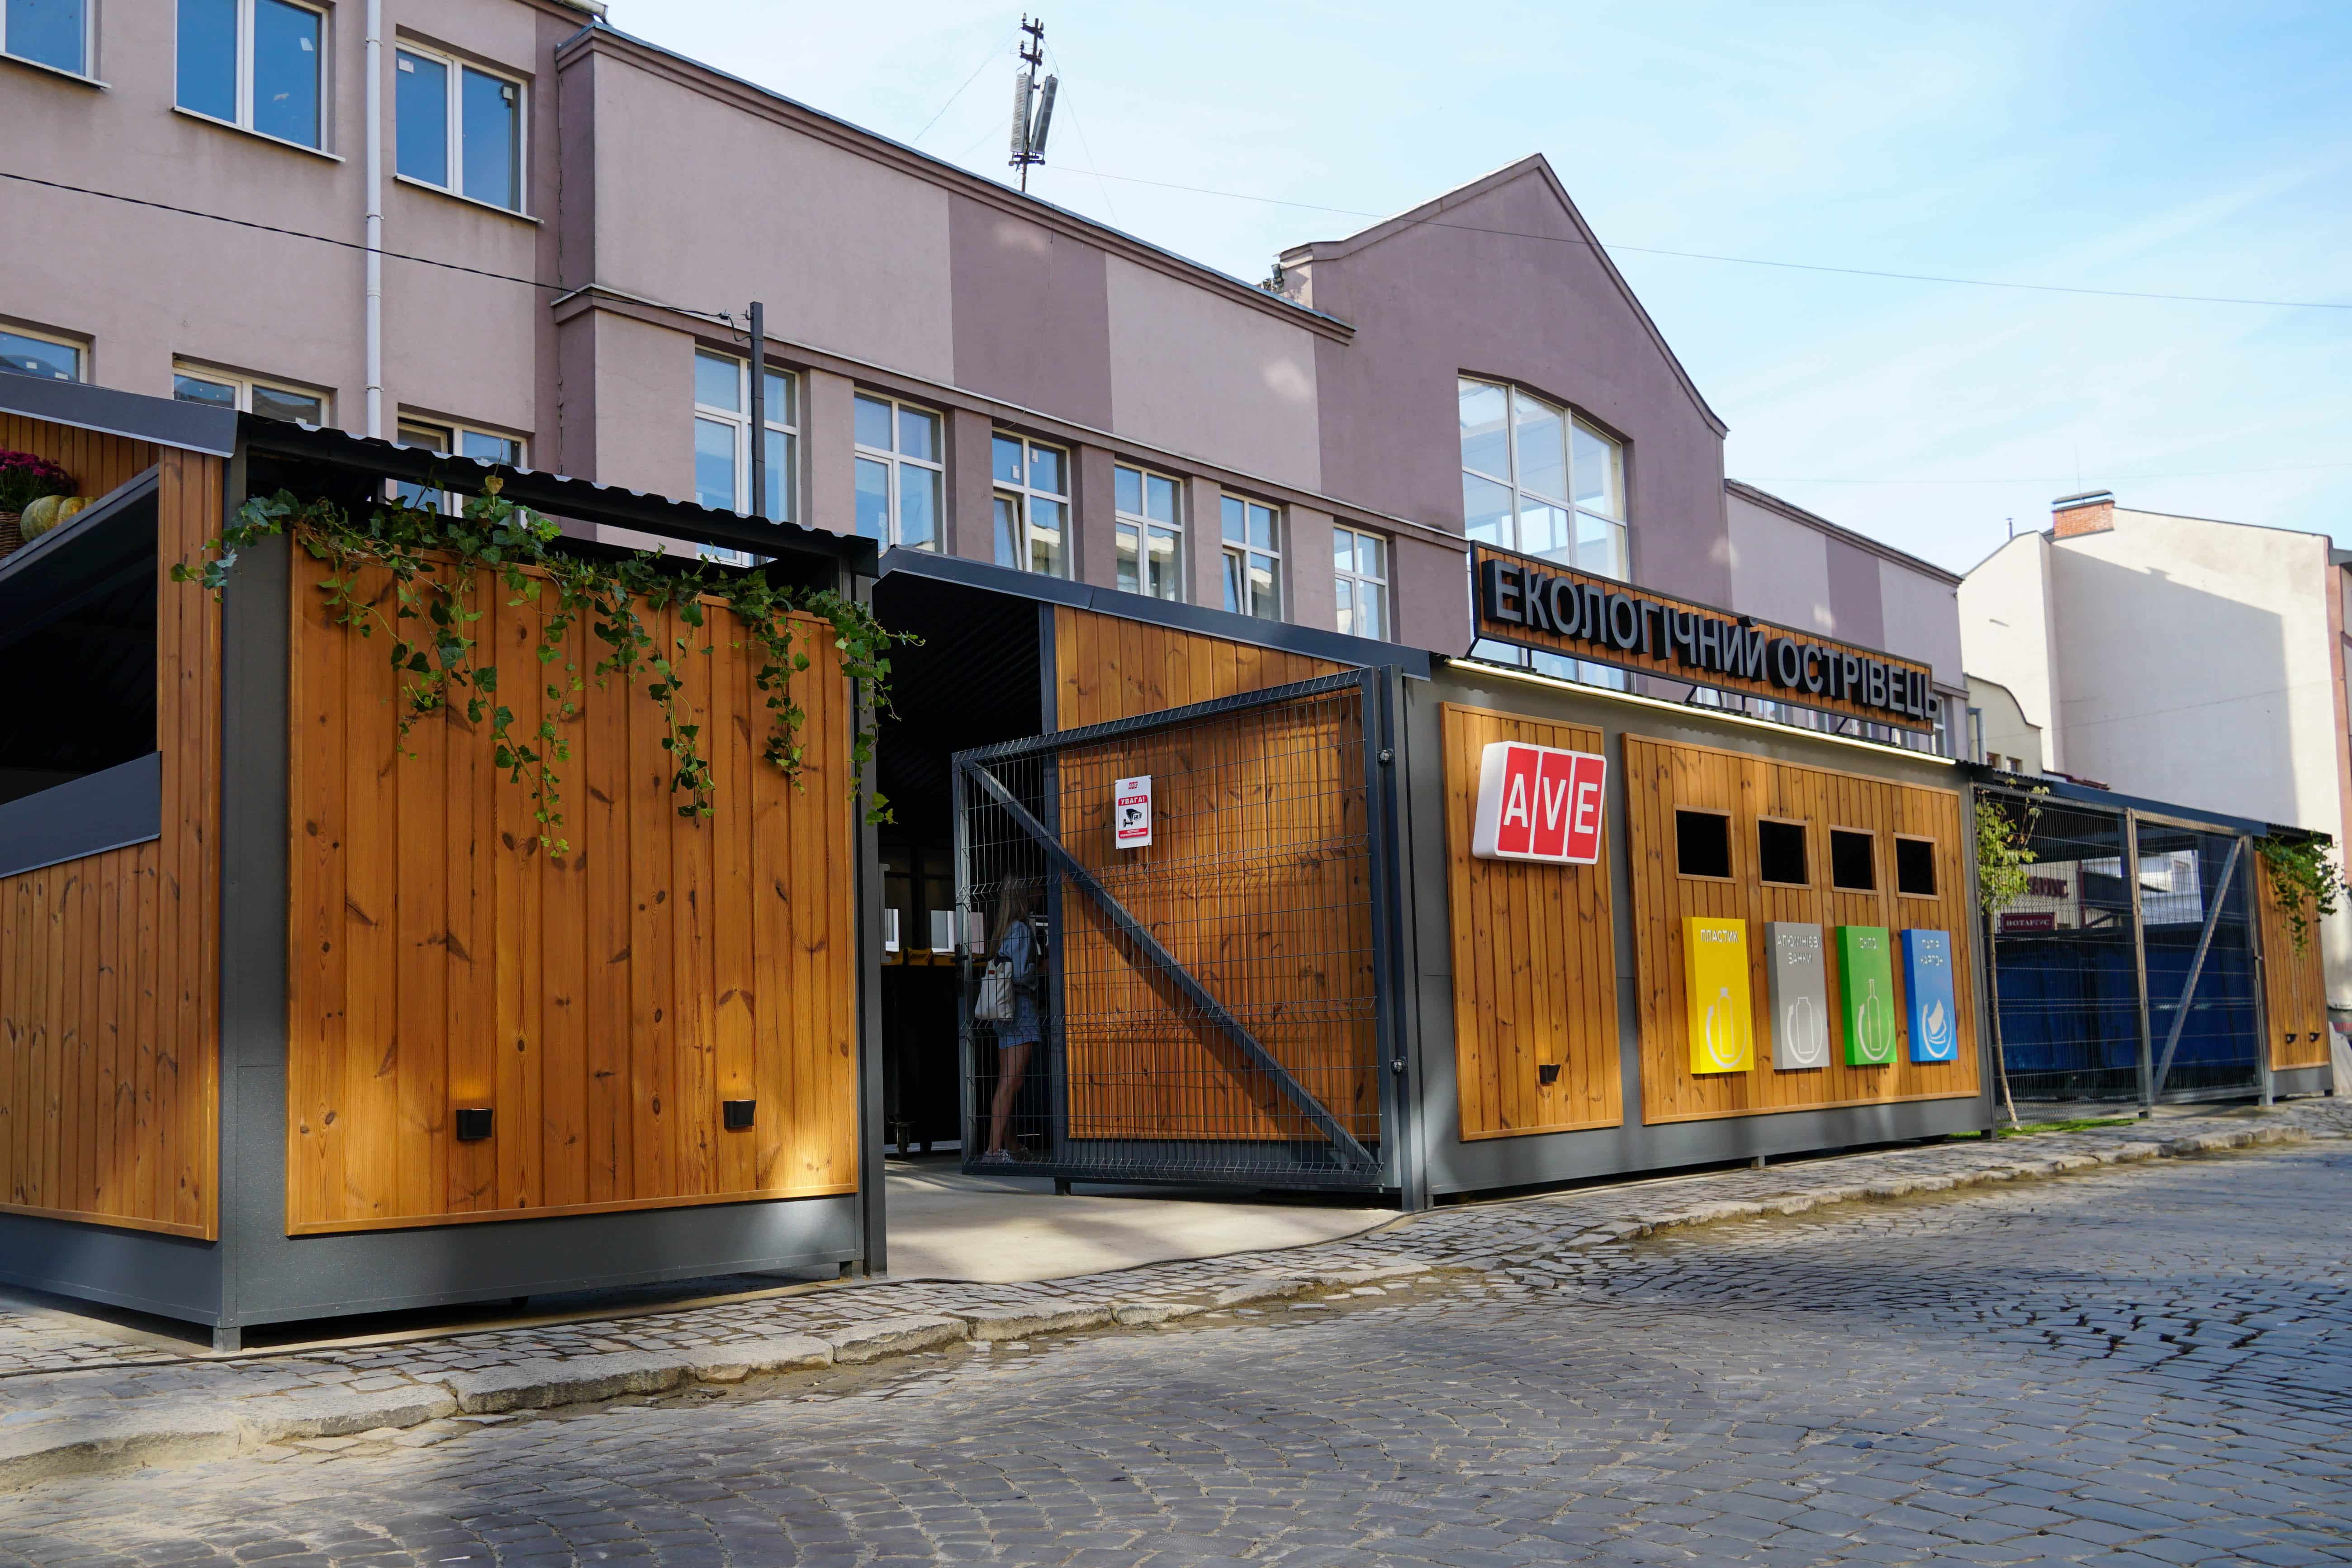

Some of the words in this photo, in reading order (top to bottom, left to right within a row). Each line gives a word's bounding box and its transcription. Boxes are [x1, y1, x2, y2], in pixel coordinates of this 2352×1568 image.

[1484, 559, 1766, 681] ЕКОЛОГІЧНИЙ
[1769, 637, 1939, 720] ОСТРІВЕЦЬ
[1121, 796, 1145, 805] УВАГА!
[1503, 773, 1598, 834] AVE
[1701, 929, 1739, 943] ПЛАСТИК
[1921, 939, 1940, 949] ПАПР
[1788, 952, 1812, 964] БАНКИ
